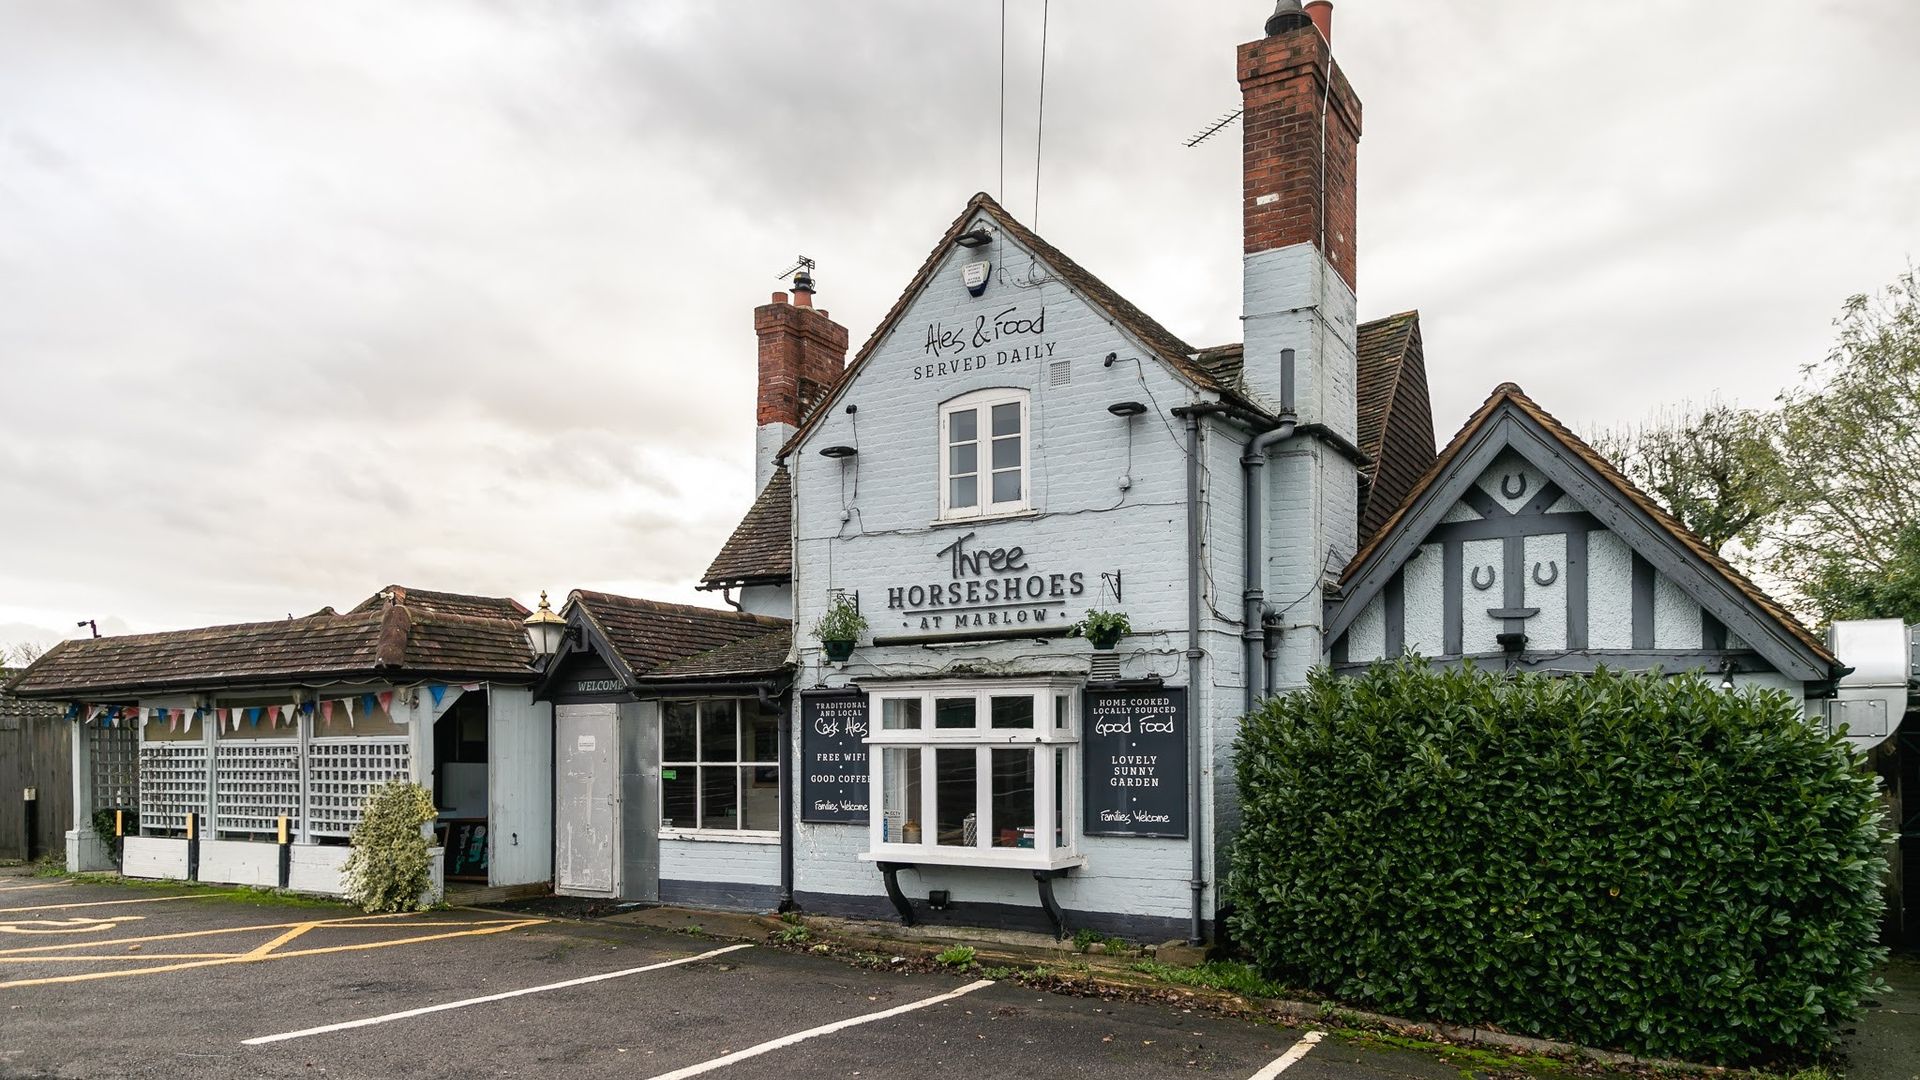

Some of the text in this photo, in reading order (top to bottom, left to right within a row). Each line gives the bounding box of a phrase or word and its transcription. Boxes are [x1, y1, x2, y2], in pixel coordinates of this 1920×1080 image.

[925, 306, 1045, 357] Ales & Food
[913, 341, 1057, 380] SERVED DAILY
[936, 532, 1029, 579] Three
[887, 571, 1085, 609] HORSESHOES
[920, 608, 1047, 629] AT MARLOW
[578, 680, 623, 691] WELCOME
[1130, 698, 1170, 706] COOKED
[838, 709, 862, 717] LOCAL
[1093, 706, 1176, 715] LOCALLY SOURCED
[814, 716, 868, 737] Cask Ales
[1095, 715, 1174, 737] Good Food
[817, 753, 866, 761] FREE WIFI
[1111, 755, 1158, 765] LOVELY
[1114, 767, 1155, 775] SUNNY
[811, 775, 835, 783] GOOD
[1110, 777, 1159, 787] GARDEN
[814, 799, 869, 813] Families Welcome
[1100, 809, 1170, 824] Families Welcome
